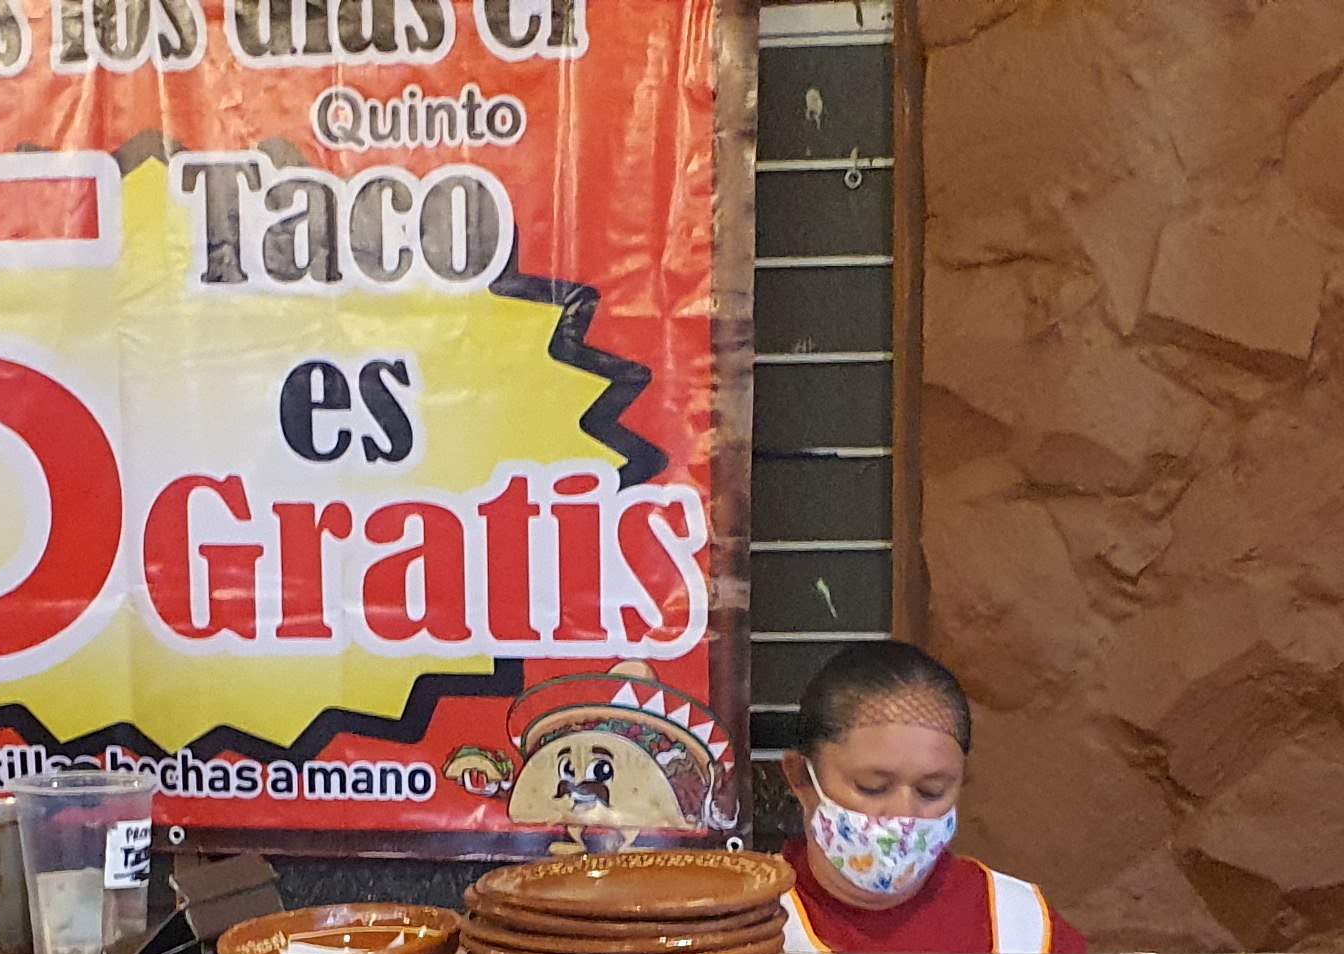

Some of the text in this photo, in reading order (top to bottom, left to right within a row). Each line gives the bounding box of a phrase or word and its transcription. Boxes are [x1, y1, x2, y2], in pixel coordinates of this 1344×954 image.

[316, 88, 522, 146] Quinto
[181, 161, 500, 284] Taco
[279, 359, 413, 462] es
[143, 473, 692, 643] Gratis
[111, 748, 264, 794] hchas
[268, 765, 293, 794] a
[310, 764, 435, 796] mano
